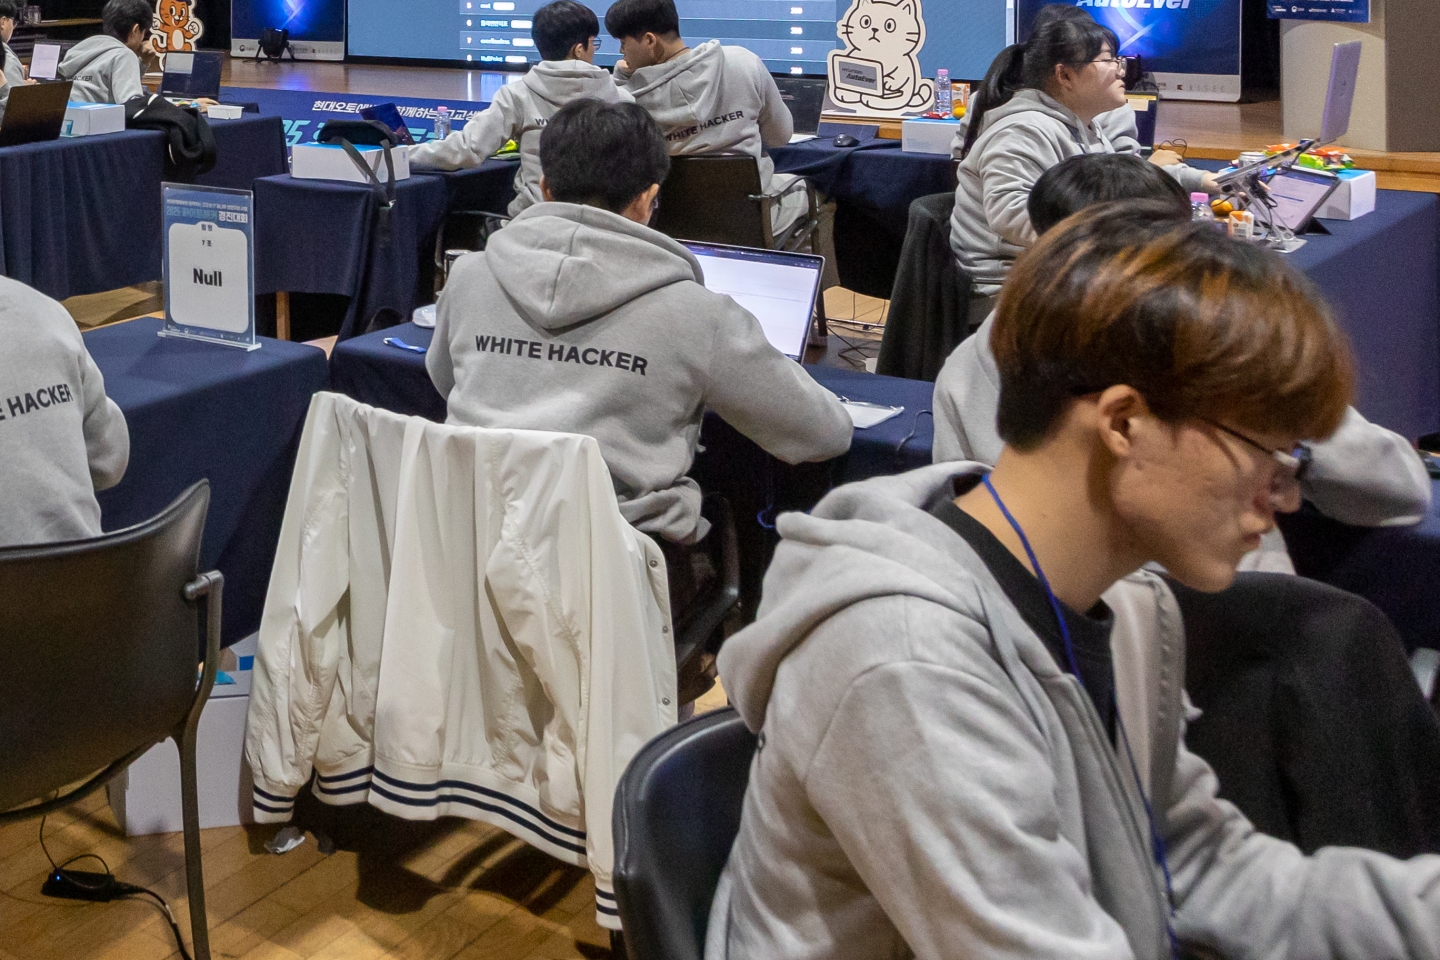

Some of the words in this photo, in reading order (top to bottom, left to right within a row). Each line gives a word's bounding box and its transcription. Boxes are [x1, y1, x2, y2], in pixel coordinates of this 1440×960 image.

[846, 73, 876, 84] AutoEver
[665, 125, 698, 141] WHITE
[700, 110, 745, 131] HACKER
[193, 268, 222, 287] Null
[475, 335, 543, 359] WHITE
[547, 343, 648, 376] HACKER
[6, 384, 74, 418] HACKER
